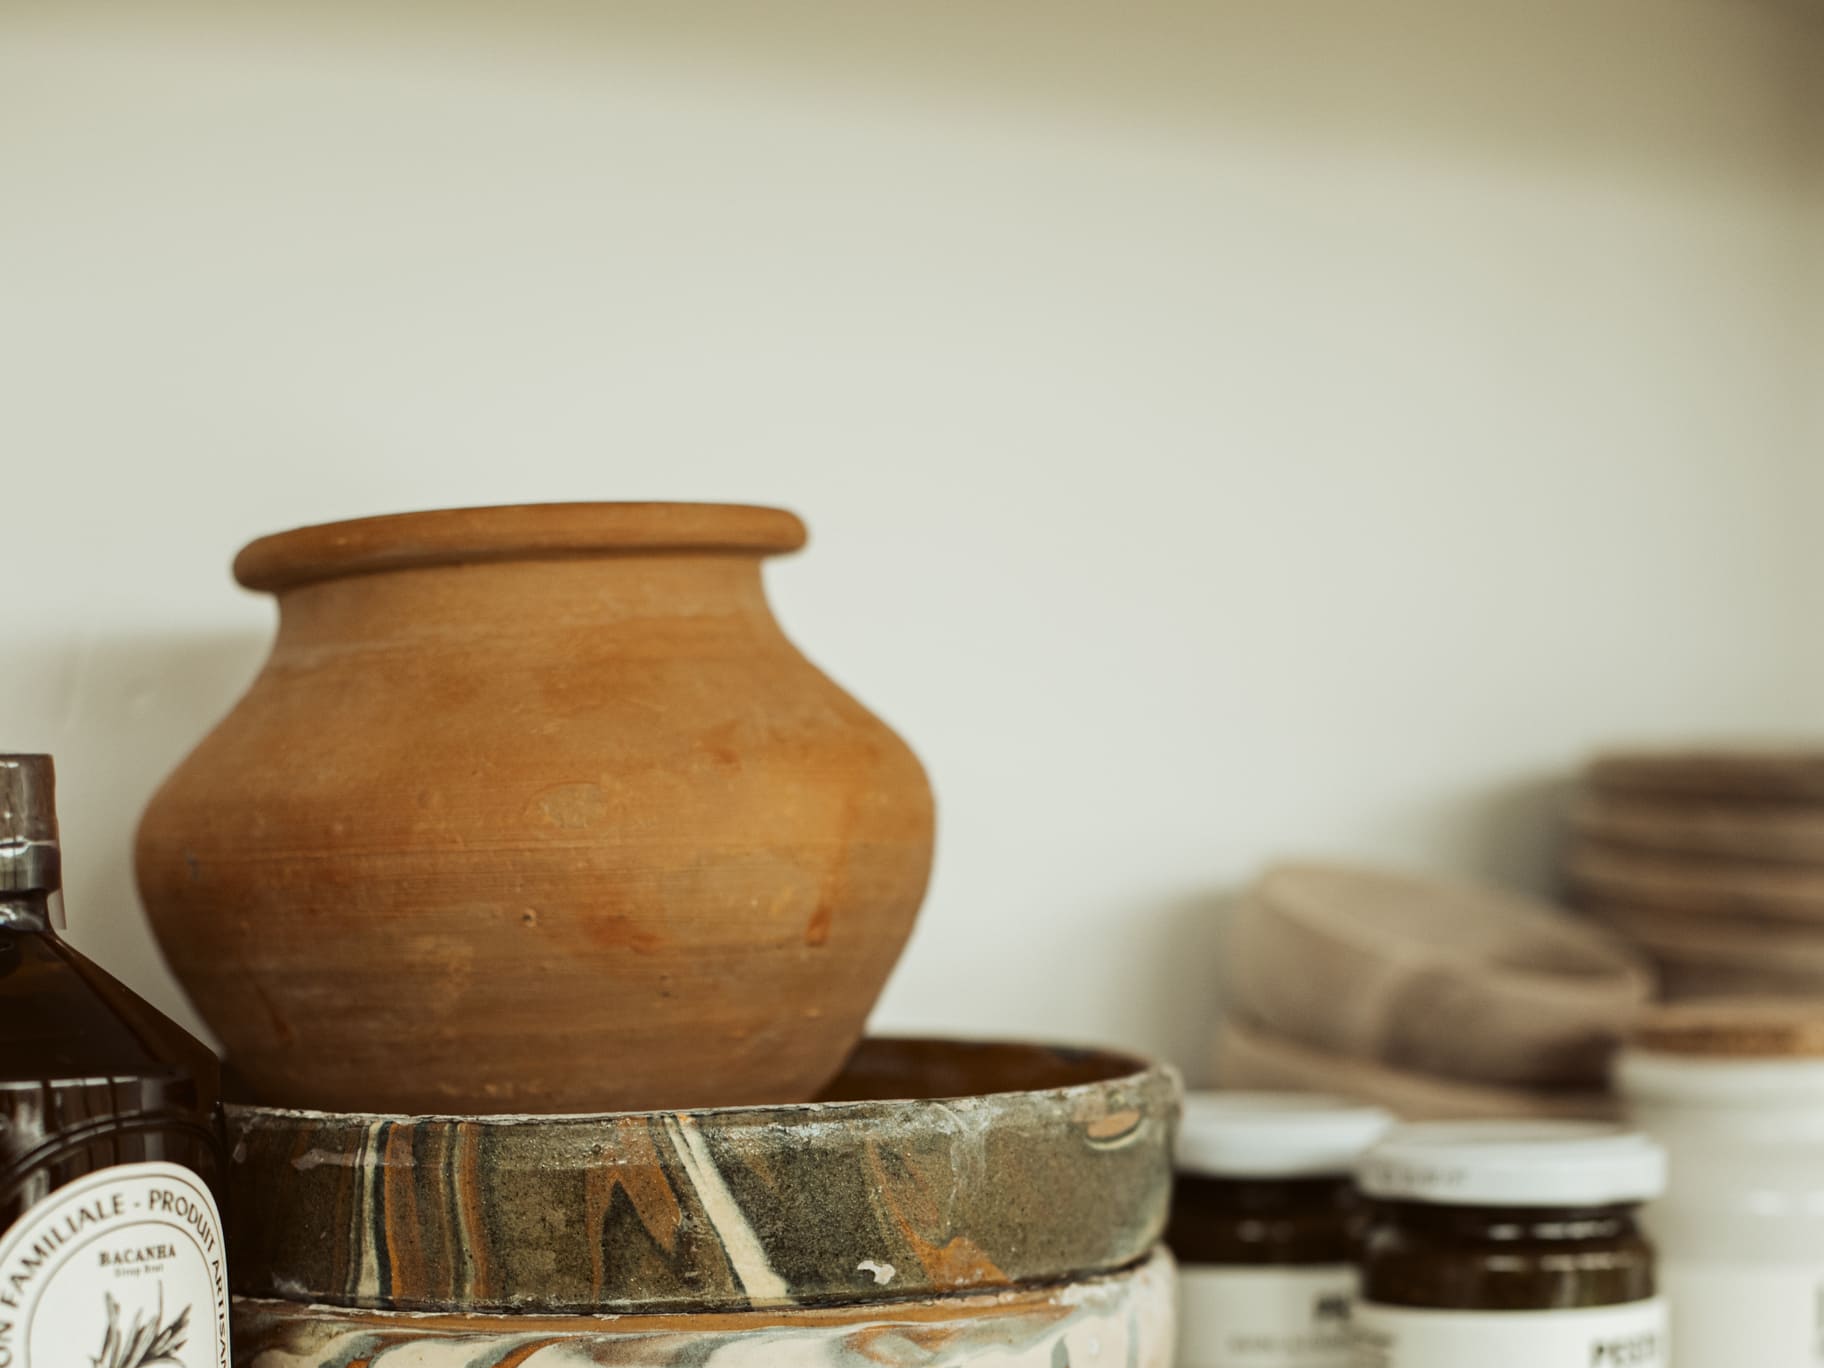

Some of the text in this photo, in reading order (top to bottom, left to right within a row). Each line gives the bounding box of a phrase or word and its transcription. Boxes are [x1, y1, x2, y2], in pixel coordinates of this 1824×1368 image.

[0, 1193, 124, 1309] FAMILIALE
[149, 1189, 216, 1253] PRODUIT
[100, 1243, 176, 1267] BACANHA
